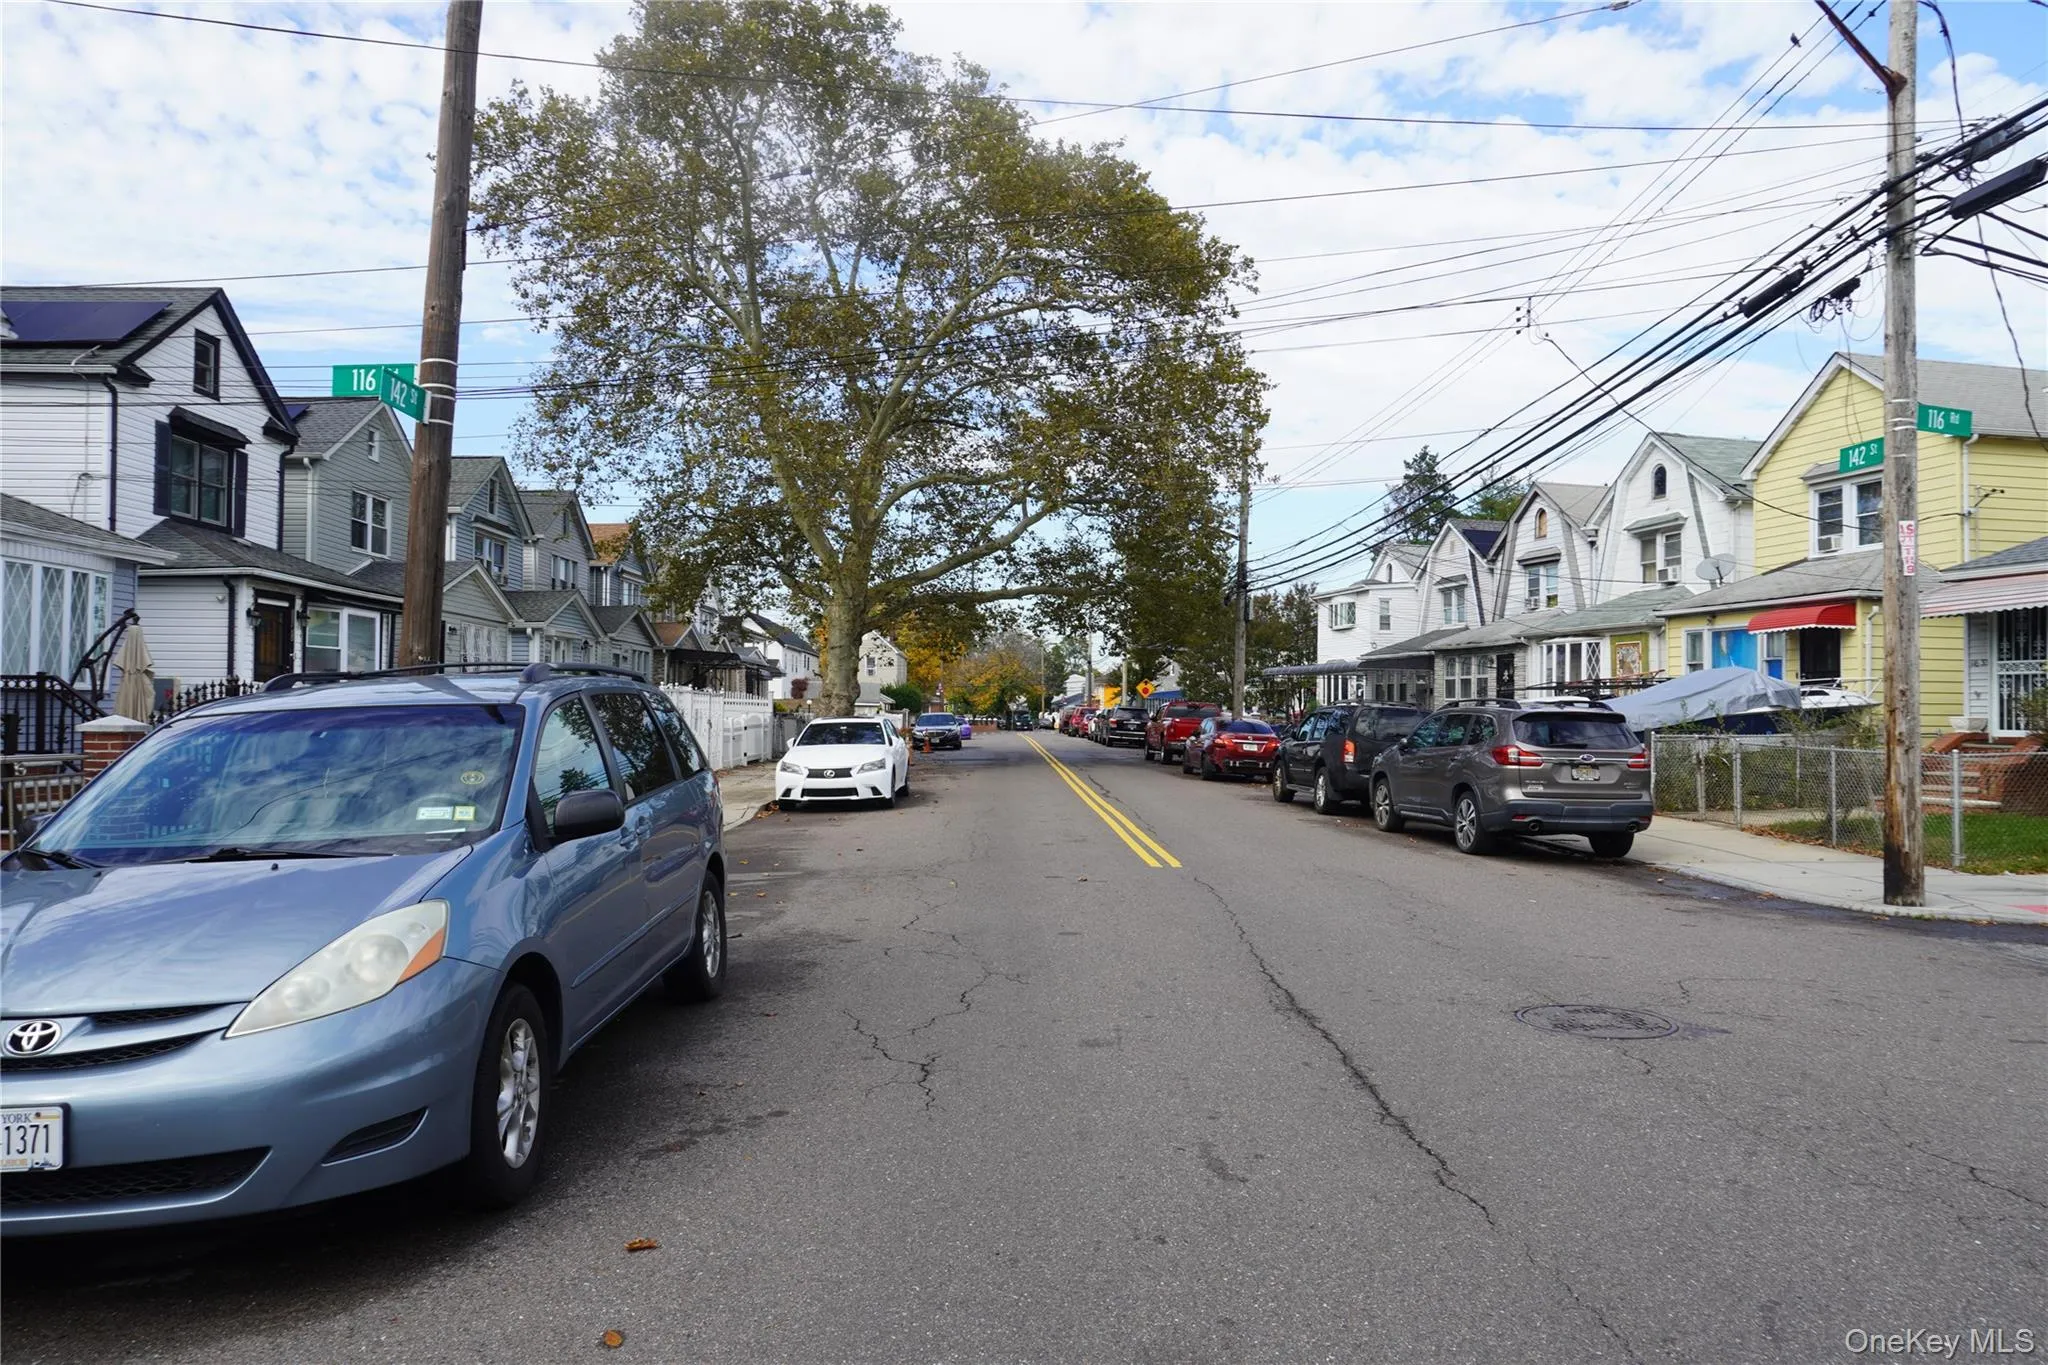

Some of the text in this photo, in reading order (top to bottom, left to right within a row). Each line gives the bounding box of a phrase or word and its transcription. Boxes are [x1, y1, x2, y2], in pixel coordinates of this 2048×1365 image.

[352, 368, 377, 391] 116
[390, 377, 408, 408] 142
[1928, 409, 1960, 430] 116 Rd
[1849, 446, 1866, 468] 142
[1, 1113, 32, 1124] YORK
